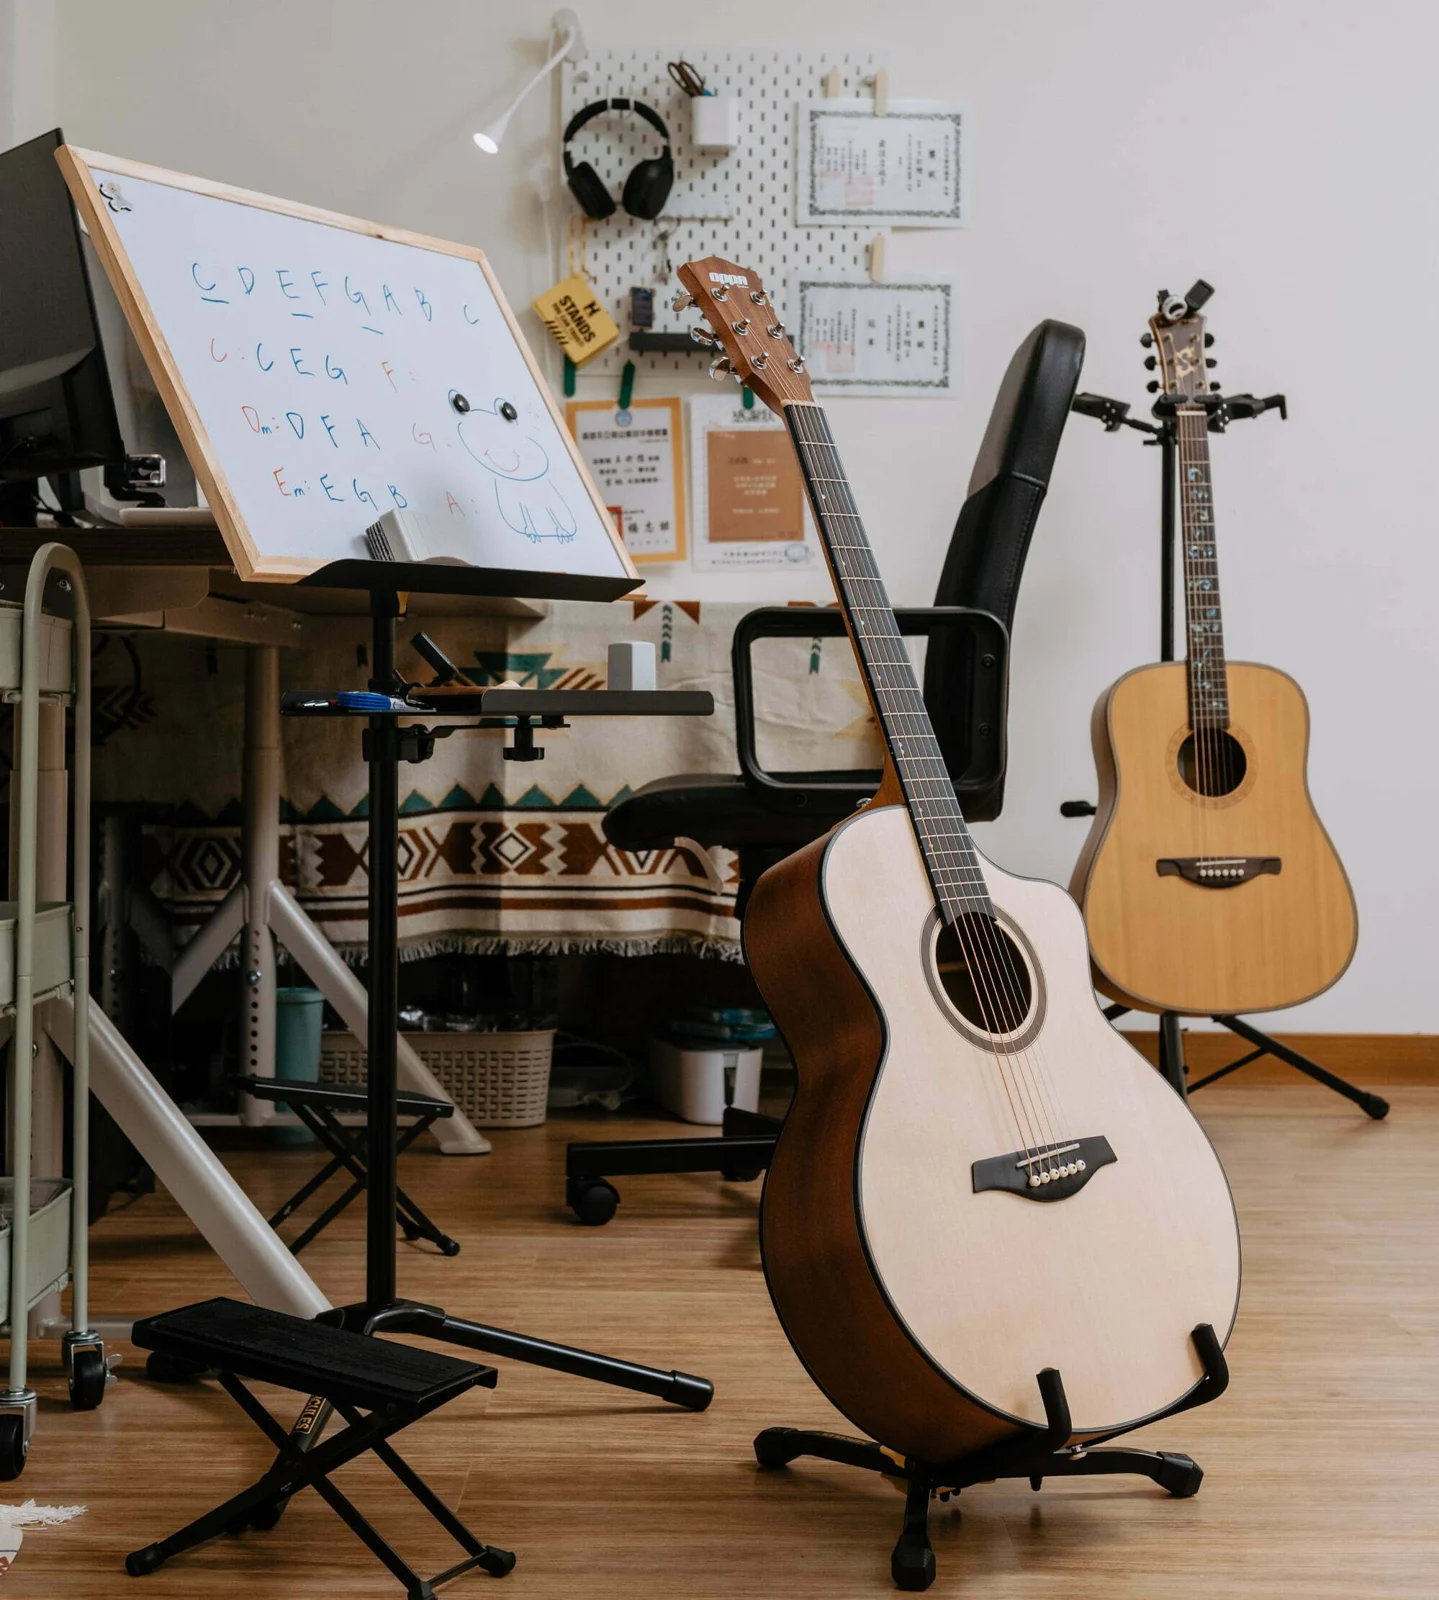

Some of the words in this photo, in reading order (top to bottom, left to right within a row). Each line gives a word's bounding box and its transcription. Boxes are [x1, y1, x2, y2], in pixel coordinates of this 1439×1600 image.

[192, 262, 216, 291] C
[237, 265, 255, 296] D
[275, 269, 300, 299] E
[311, 271, 329, 306] F
[345, 275, 371, 317] G
[382, 284, 403, 316] A
[413, 286, 432, 322] B
[463, 304, 480, 326] C
[559, 294, 597, 343] STANDS
[256, 343, 275, 372] C
[290, 348, 315, 376] E
[325, 354, 348, 385] G
[286, 412, 305, 440] D
[320, 415, 339, 449] F
[356, 417, 381, 451] A
[319, 473, 345, 502] E
[353, 478, 379, 511] G
[387, 483, 408, 509] B
